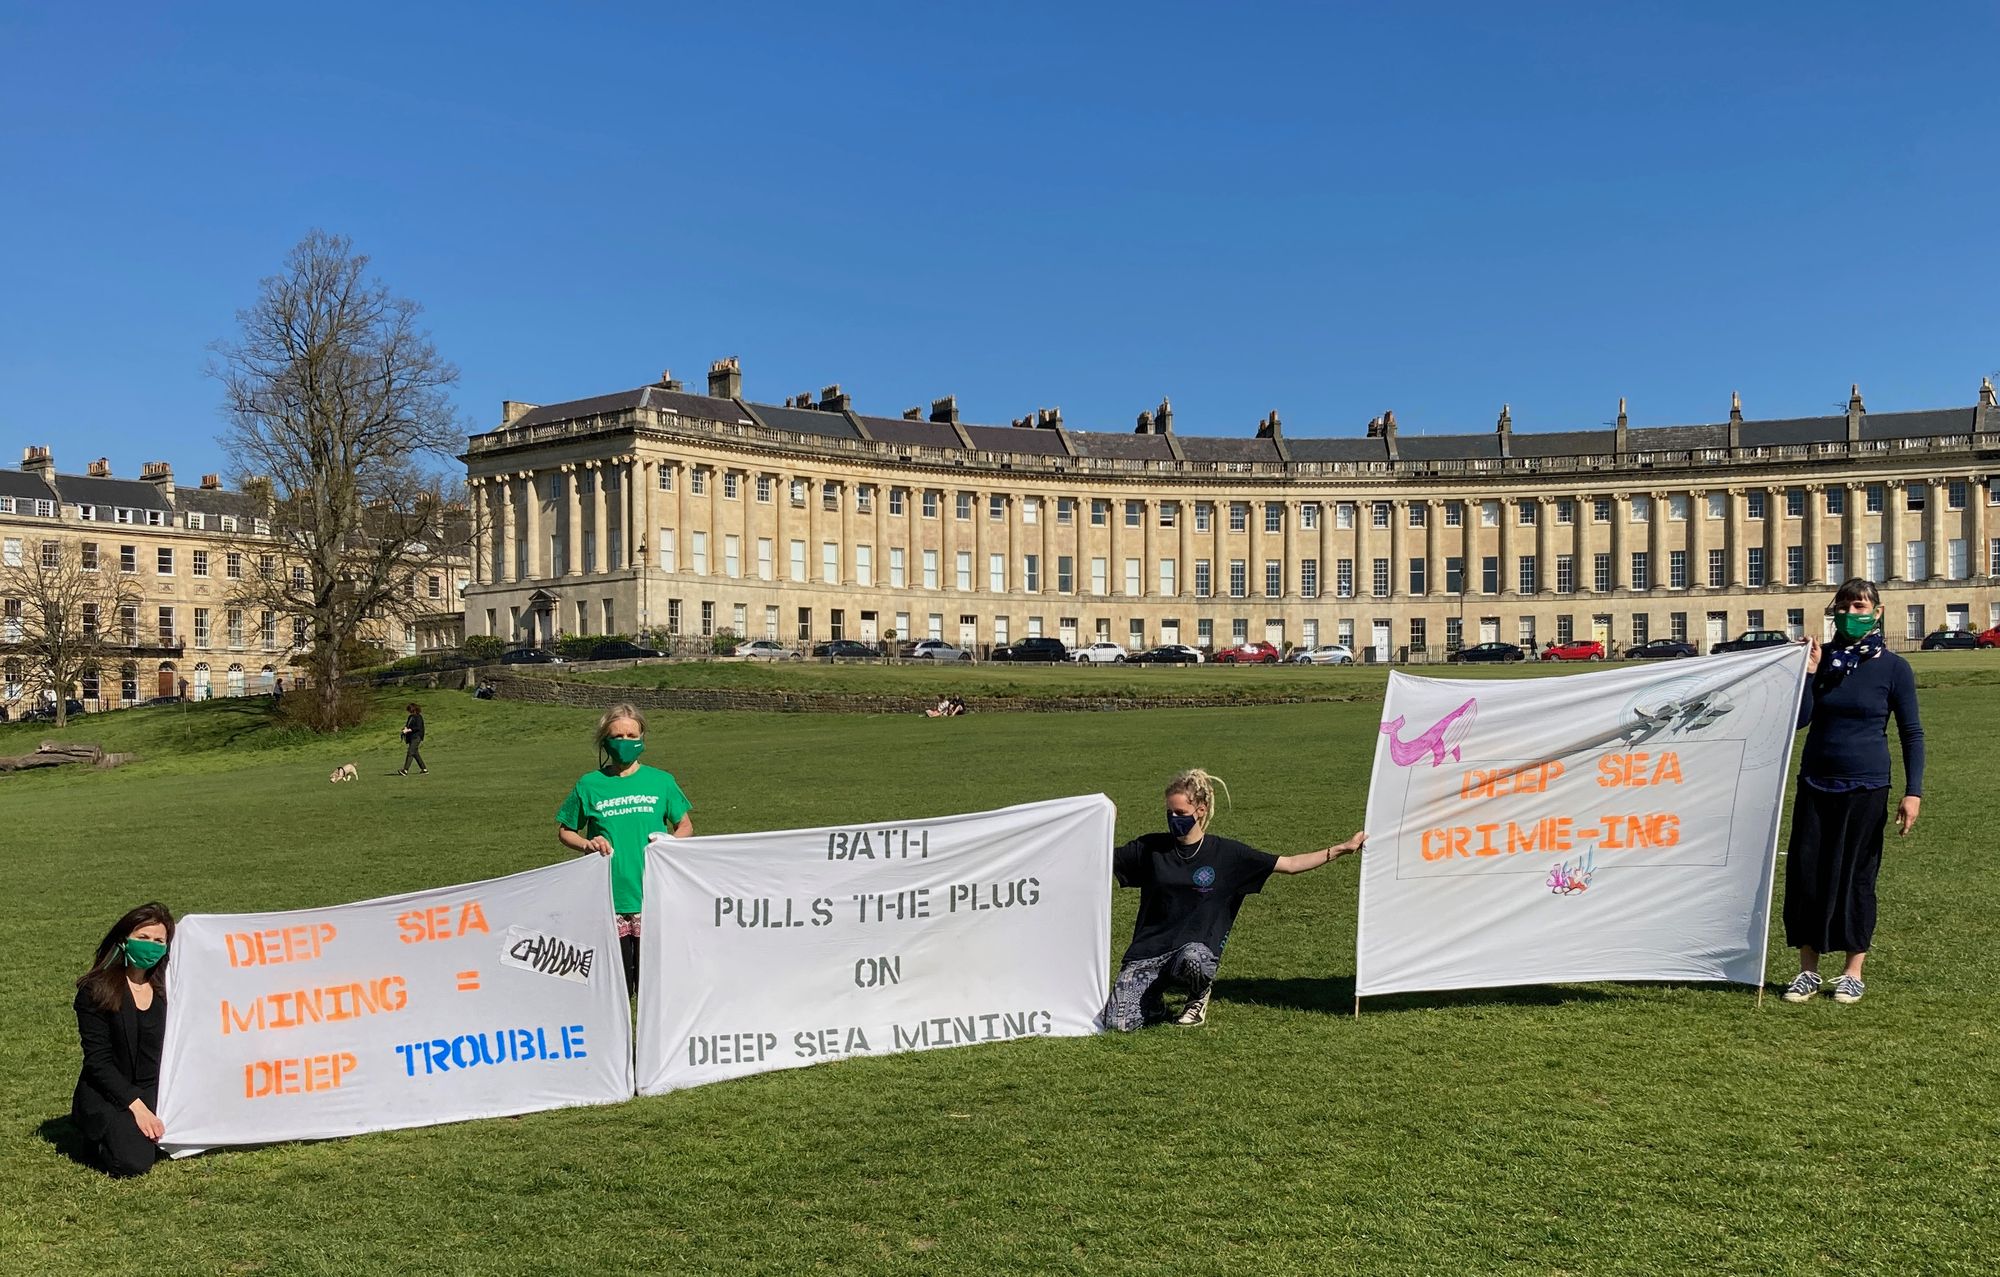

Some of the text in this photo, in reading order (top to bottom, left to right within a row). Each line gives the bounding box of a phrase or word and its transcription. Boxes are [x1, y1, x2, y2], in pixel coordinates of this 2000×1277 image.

[1460, 752, 1683, 800] DEEP SEA
[595, 794, 659, 811] GREENPEACE
[602, 806, 655, 817] VOLUNTEER
[828, 830, 928, 860] BATH
[1421, 813, 1681, 862] CRIME-ING
[715, 877, 1040, 928] PULLS THE PLUG
[224, 900, 490, 968] DEEP SEA
[854, 955, 901, 988] ON
[221, 971, 480, 1035] MINING =
[244, 1024, 587, 1099] DEEP TROUBLE
[688, 1010, 1052, 1066] DEEP SEA MINING
